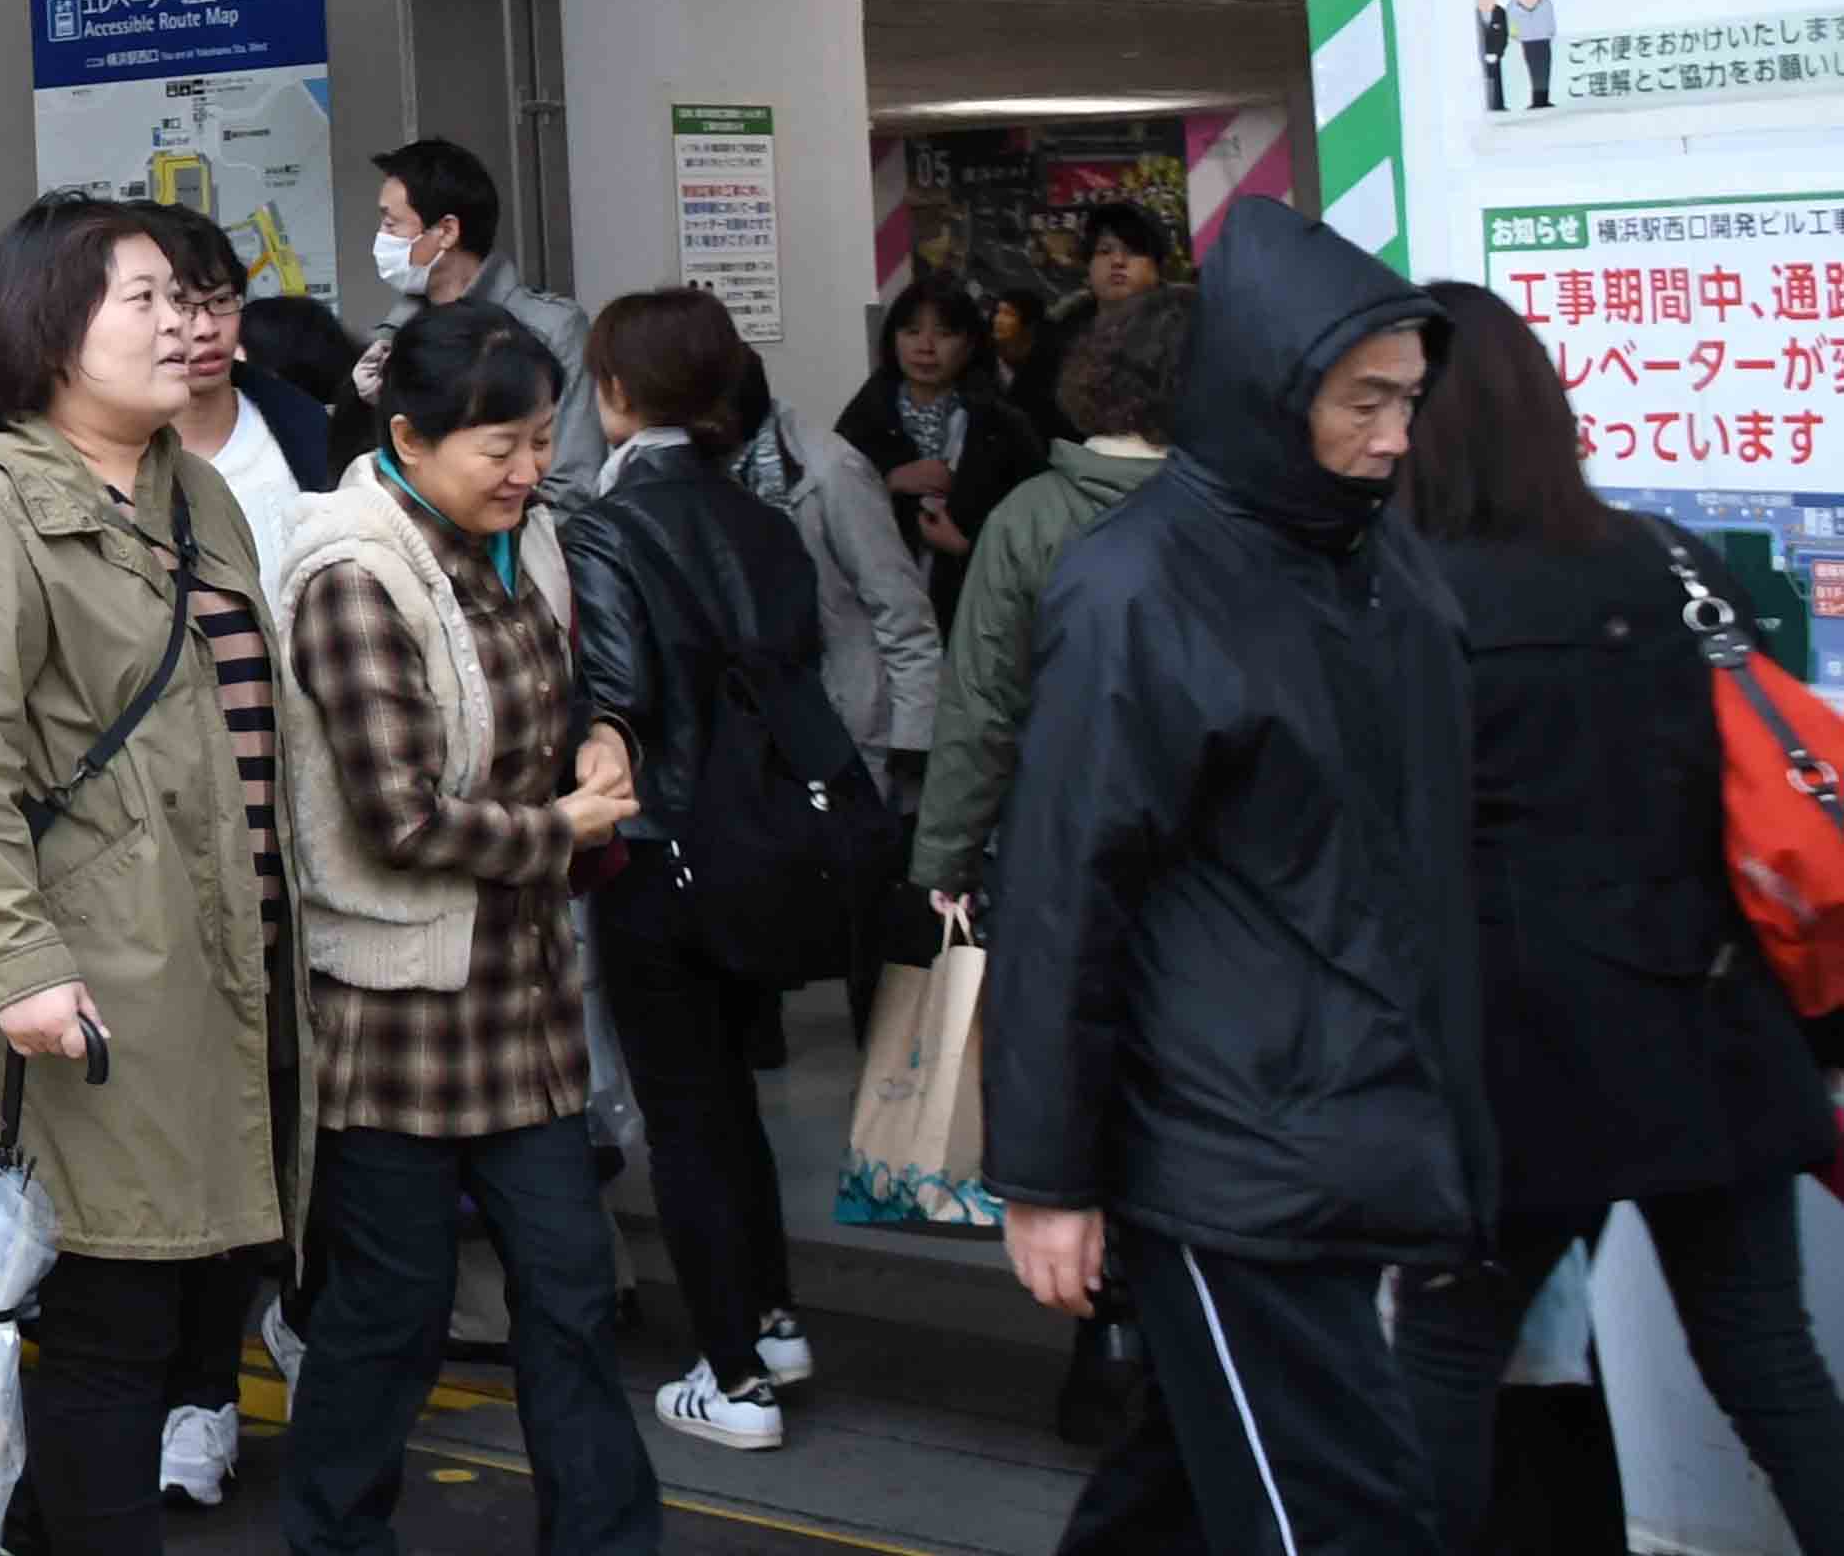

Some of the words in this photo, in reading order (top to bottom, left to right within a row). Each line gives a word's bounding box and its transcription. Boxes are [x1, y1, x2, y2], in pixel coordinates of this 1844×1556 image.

[83, 15, 155, 38] Accessible
[159, 10, 201, 30] Route
[206, 7, 239, 28] Map
[1492, 216, 1579, 245] お知らせ
